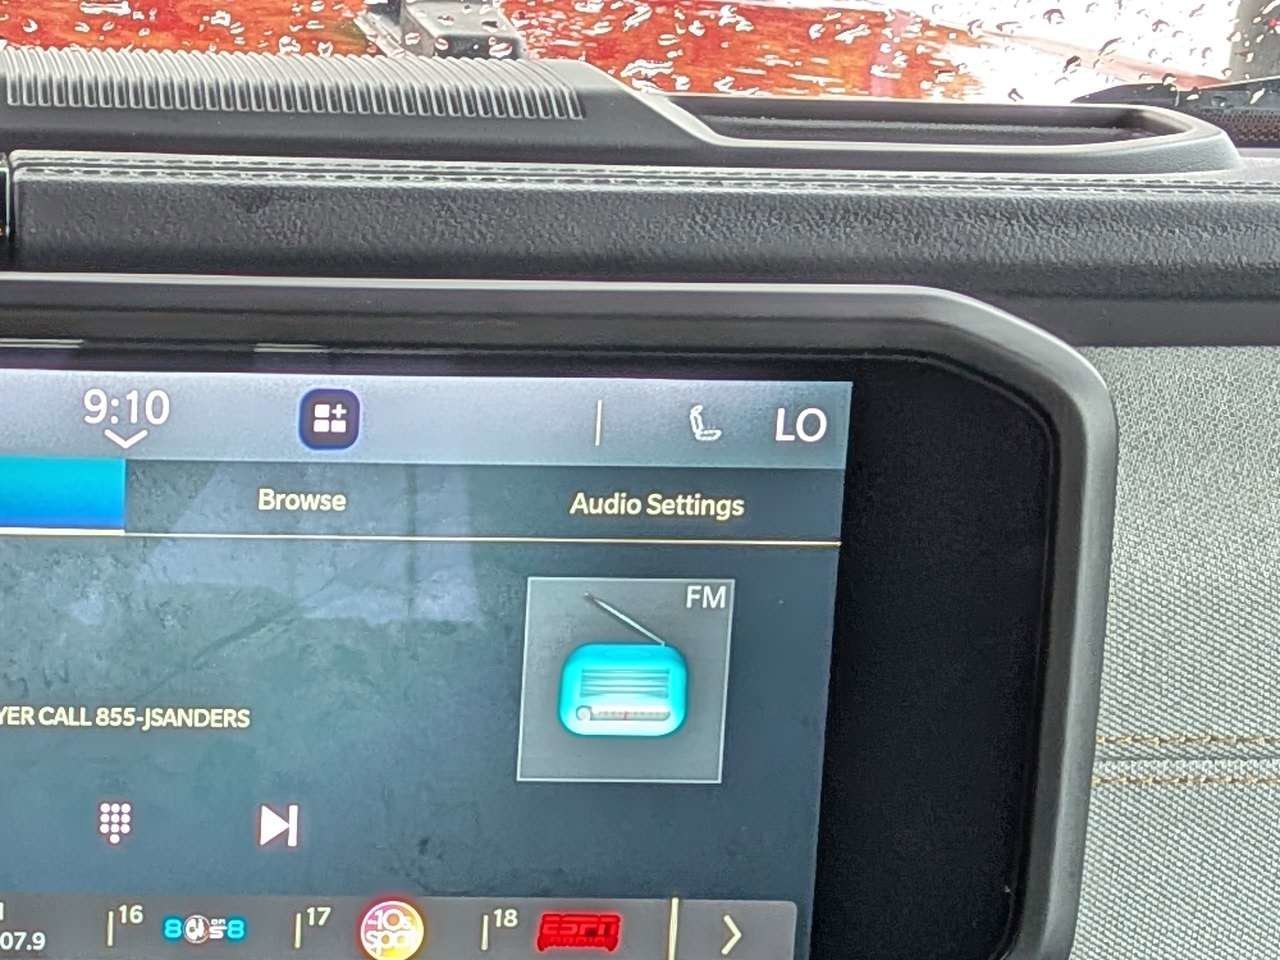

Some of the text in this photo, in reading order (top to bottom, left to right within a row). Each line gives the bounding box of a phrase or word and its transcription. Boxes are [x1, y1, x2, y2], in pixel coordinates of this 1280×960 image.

[83, 389, 170, 425] 9:10
[776, 407, 827, 442] LO
[258, 488, 347, 512] Browse
[569, 492, 745, 521] Audio Settings
[686, 586, 727, 609] FM
[38, 706, 92, 727] CALL
[95, 708, 251, 731] 855-JSANDERS
[119, 904, 143, 924] 16
[306, 906, 331, 926] 17
[493, 908, 518, 928] 18
